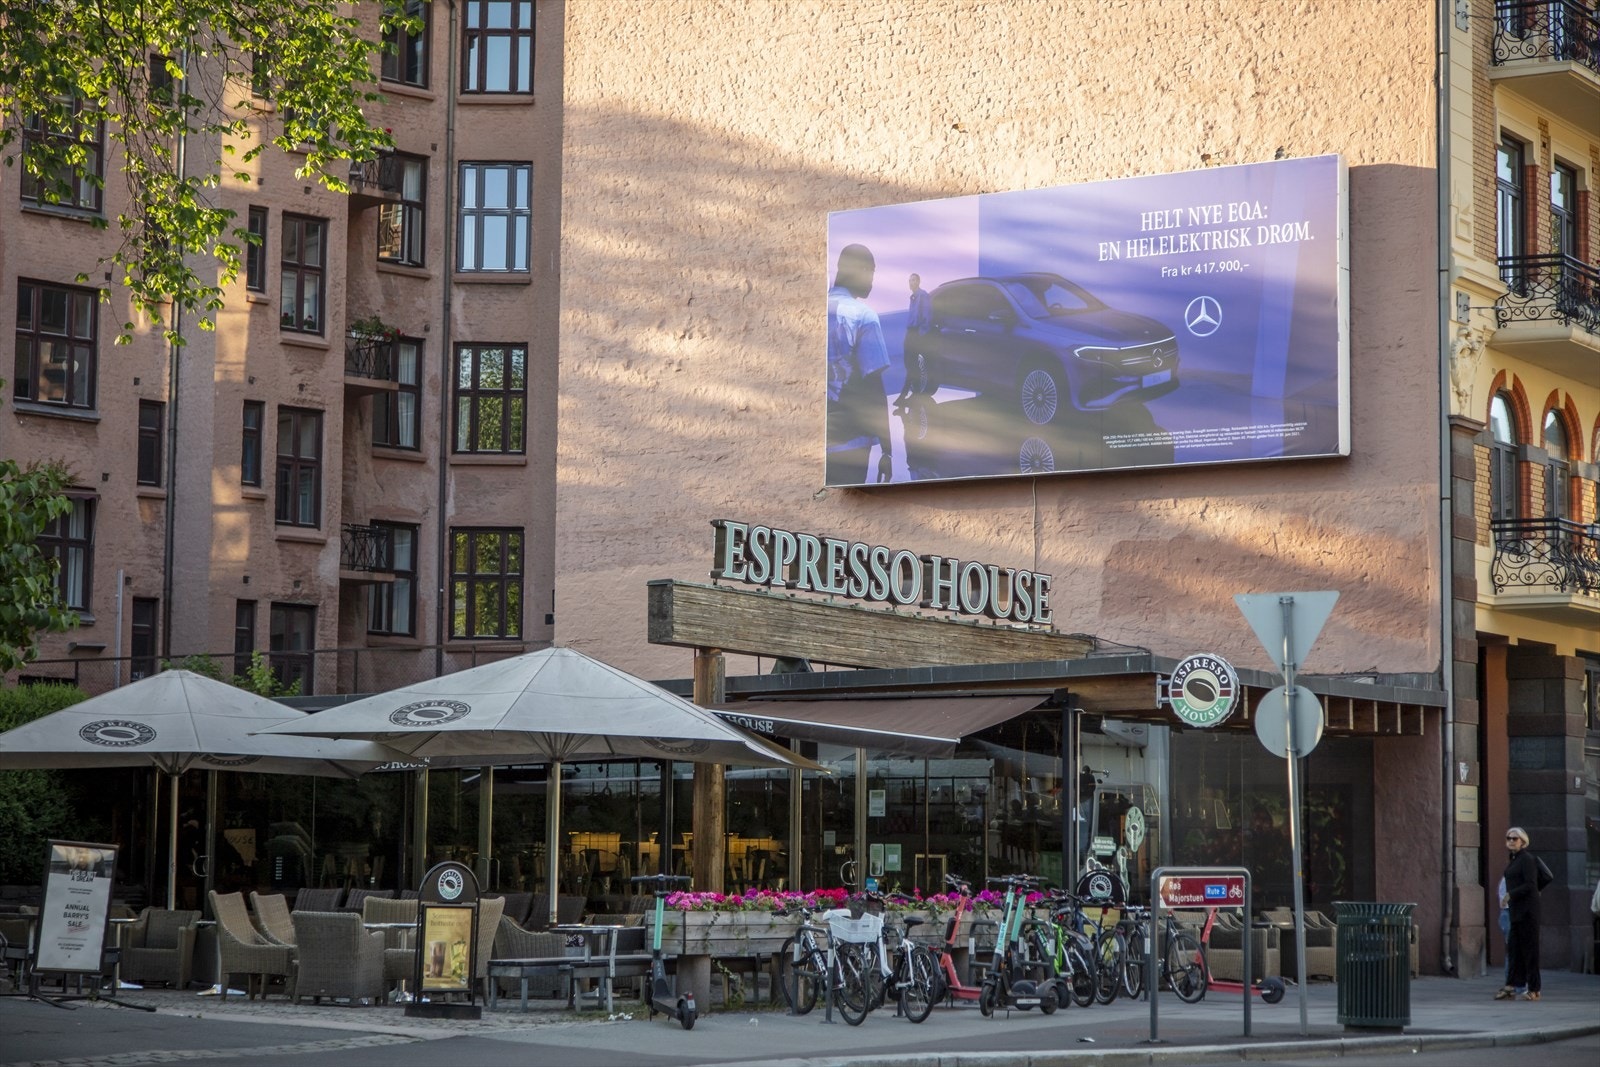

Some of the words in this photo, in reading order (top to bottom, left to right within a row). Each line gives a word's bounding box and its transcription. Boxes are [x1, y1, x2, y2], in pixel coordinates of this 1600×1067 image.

[1140, 208, 1184, 232] HELT
[1187, 204, 1223, 226] NYE
[1228, 200, 1269, 222] EQA:
[1098, 241, 1121, 262] EN
[1125, 226, 1252, 260] HELELEKTRISK
[1256, 221, 1315, 246] DRØM.
[1161, 266, 1178, 278] Fra
[1180, 264, 1193, 276] kr
[1194, 259, 1250, 275] 417.900,-
[718, 519, 922, 606] ESPRESSO
[927, 554, 1053, 625] HOUSE
[1174, 658, 1229, 685] ESPRESSO
[1180, 704, 1223, 722] HOUSE
[1168, 881, 1181, 890] Røa
[1206, 887, 1220, 895] Rute
[1221, 887, 1226, 895] 2
[1168, 894, 1204, 905] Majorstuen
[64, 903, 90, 912] ANNUAL
[63, 911, 89, 920] BARRY'S
[67, 920, 82, 928] SALE
